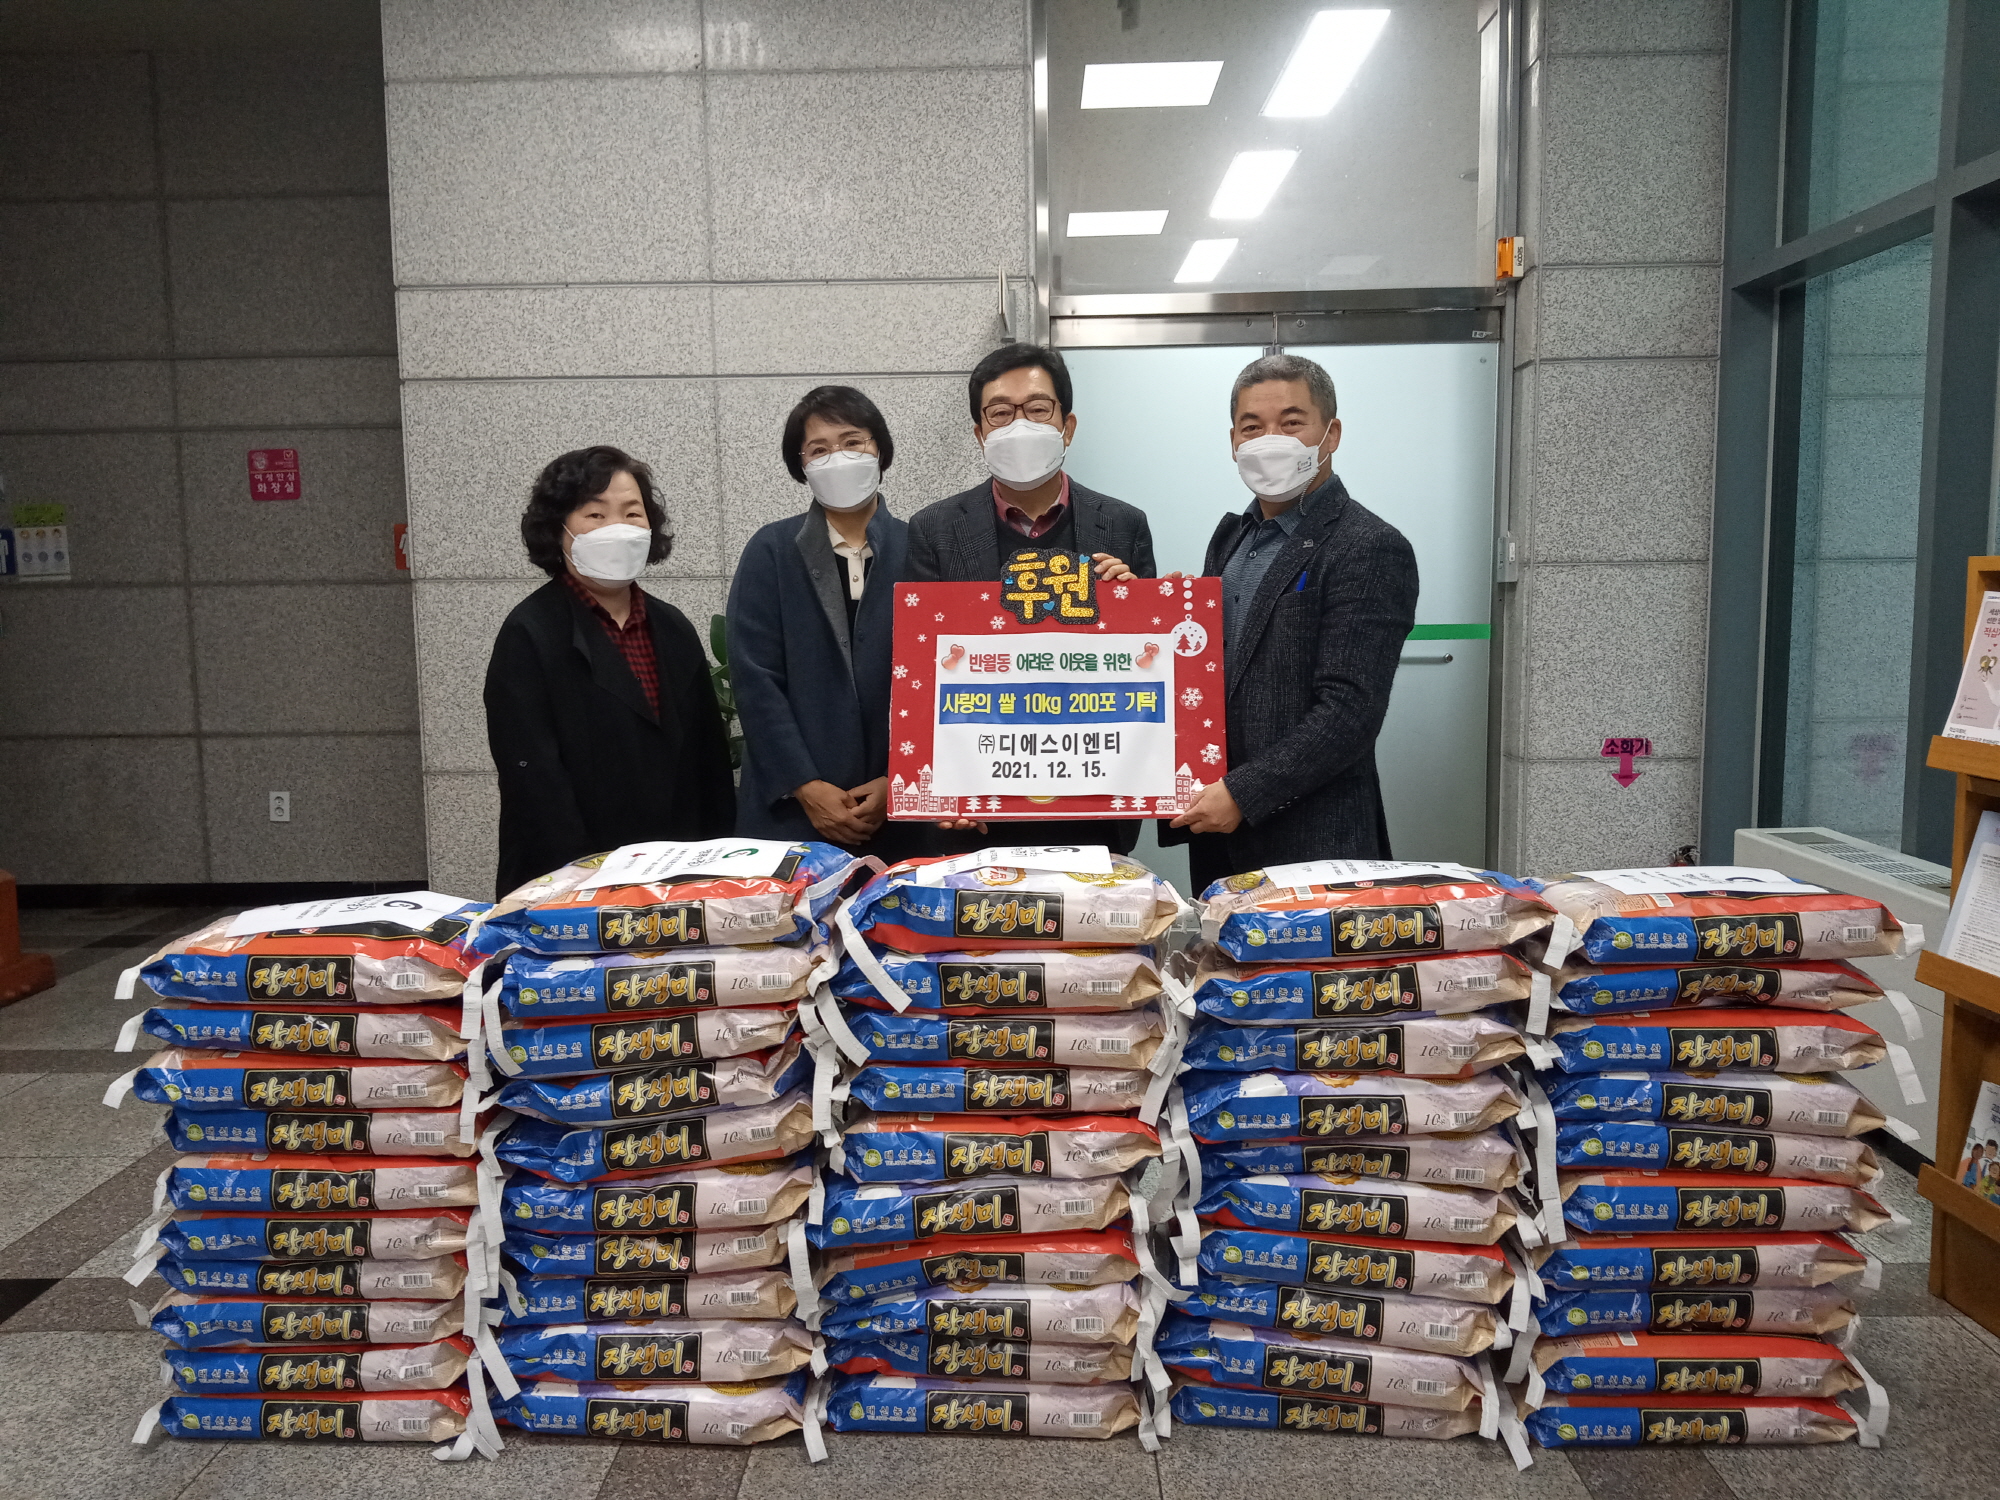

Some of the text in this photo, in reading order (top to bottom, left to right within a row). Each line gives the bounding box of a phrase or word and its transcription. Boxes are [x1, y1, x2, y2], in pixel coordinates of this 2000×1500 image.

[257, 482, 295, 493] 화장실
[1006, 552, 1095, 619] 후원
[969, 652, 1132, 672] 반월동 어려운 이웃을 위한
[942, 691, 1157, 715] 사랑의 쌀 10kg 200포 기탁
[1605, 738, 1649, 756] 소화기
[991, 761, 1106, 779] 2021. 12. 15.
[604, 908, 687, 945] 장생미
[961, 900, 1044, 932] 장생미
[1338, 911, 1423, 948] 장생미
[1704, 920, 1784, 955] 장생미
[253, 964, 334, 995] 장생미
[612, 967, 696, 1006] 장생미
[947, 972, 1026, 1001] 장생미
[1320, 973, 1400, 1009] 장생미
[257, 1021, 337, 1051] 장생미
[598, 1023, 681, 1062] 장생미
[955, 1027, 1036, 1057] 장생미
[1303, 1034, 1387, 1067] 장생미
[1677, 1034, 1760, 1067] 장생미
[250, 1077, 333, 1105] 장생미
[617, 1068, 698, 1111] 장생미
[971, 1073, 1053, 1106] 장생미
[1307, 1102, 1389, 1134] 장생미
[1669, 1093, 1753, 1124] 장생미
[272, 1121, 352, 1149] 장생미
[610, 1126, 690, 1165] 장생미
[950, 1140, 1032, 1173] 장생미
[1675, 1138, 1758, 1170] 장생미
[278, 1179, 356, 1207] 장생미
[599, 1190, 678, 1226] 장생미
[1685, 1194, 1767, 1223] 장생미
[920, 1194, 1002, 1230] 장생미
[1306, 1199, 1389, 1233] 장생미
[274, 1228, 352, 1255] 장생미
[601, 1237, 680, 1269] 장생미
[263, 1268, 342, 1295] 장생미
[1313, 1251, 1396, 1287] 장생미
[1660, 1255, 1741, 1283] 장생미
[590, 1283, 668, 1315] 장생미
[1658, 1299, 1736, 1326] 장생미
[269, 1314, 350, 1339] 장생미
[934, 1307, 1012, 1336] 장생미
[1282, 1297, 1366, 1335] 장생미
[602, 1340, 682, 1373] 장생미
[934, 1343, 1011, 1375] 장생미
[264, 1360, 343, 1386] 장생미
[1270, 1357, 1352, 1391] 장생미
[1663, 1366, 1743, 1392] 장생미
[267, 1410, 343, 1437] 장생미
[593, 1409, 670, 1437] 장생미
[932, 1400, 1011, 1430] 장생미
[1285, 1405, 1365, 1432] 장생미
[1649, 1416, 1729, 1442] 장생미
